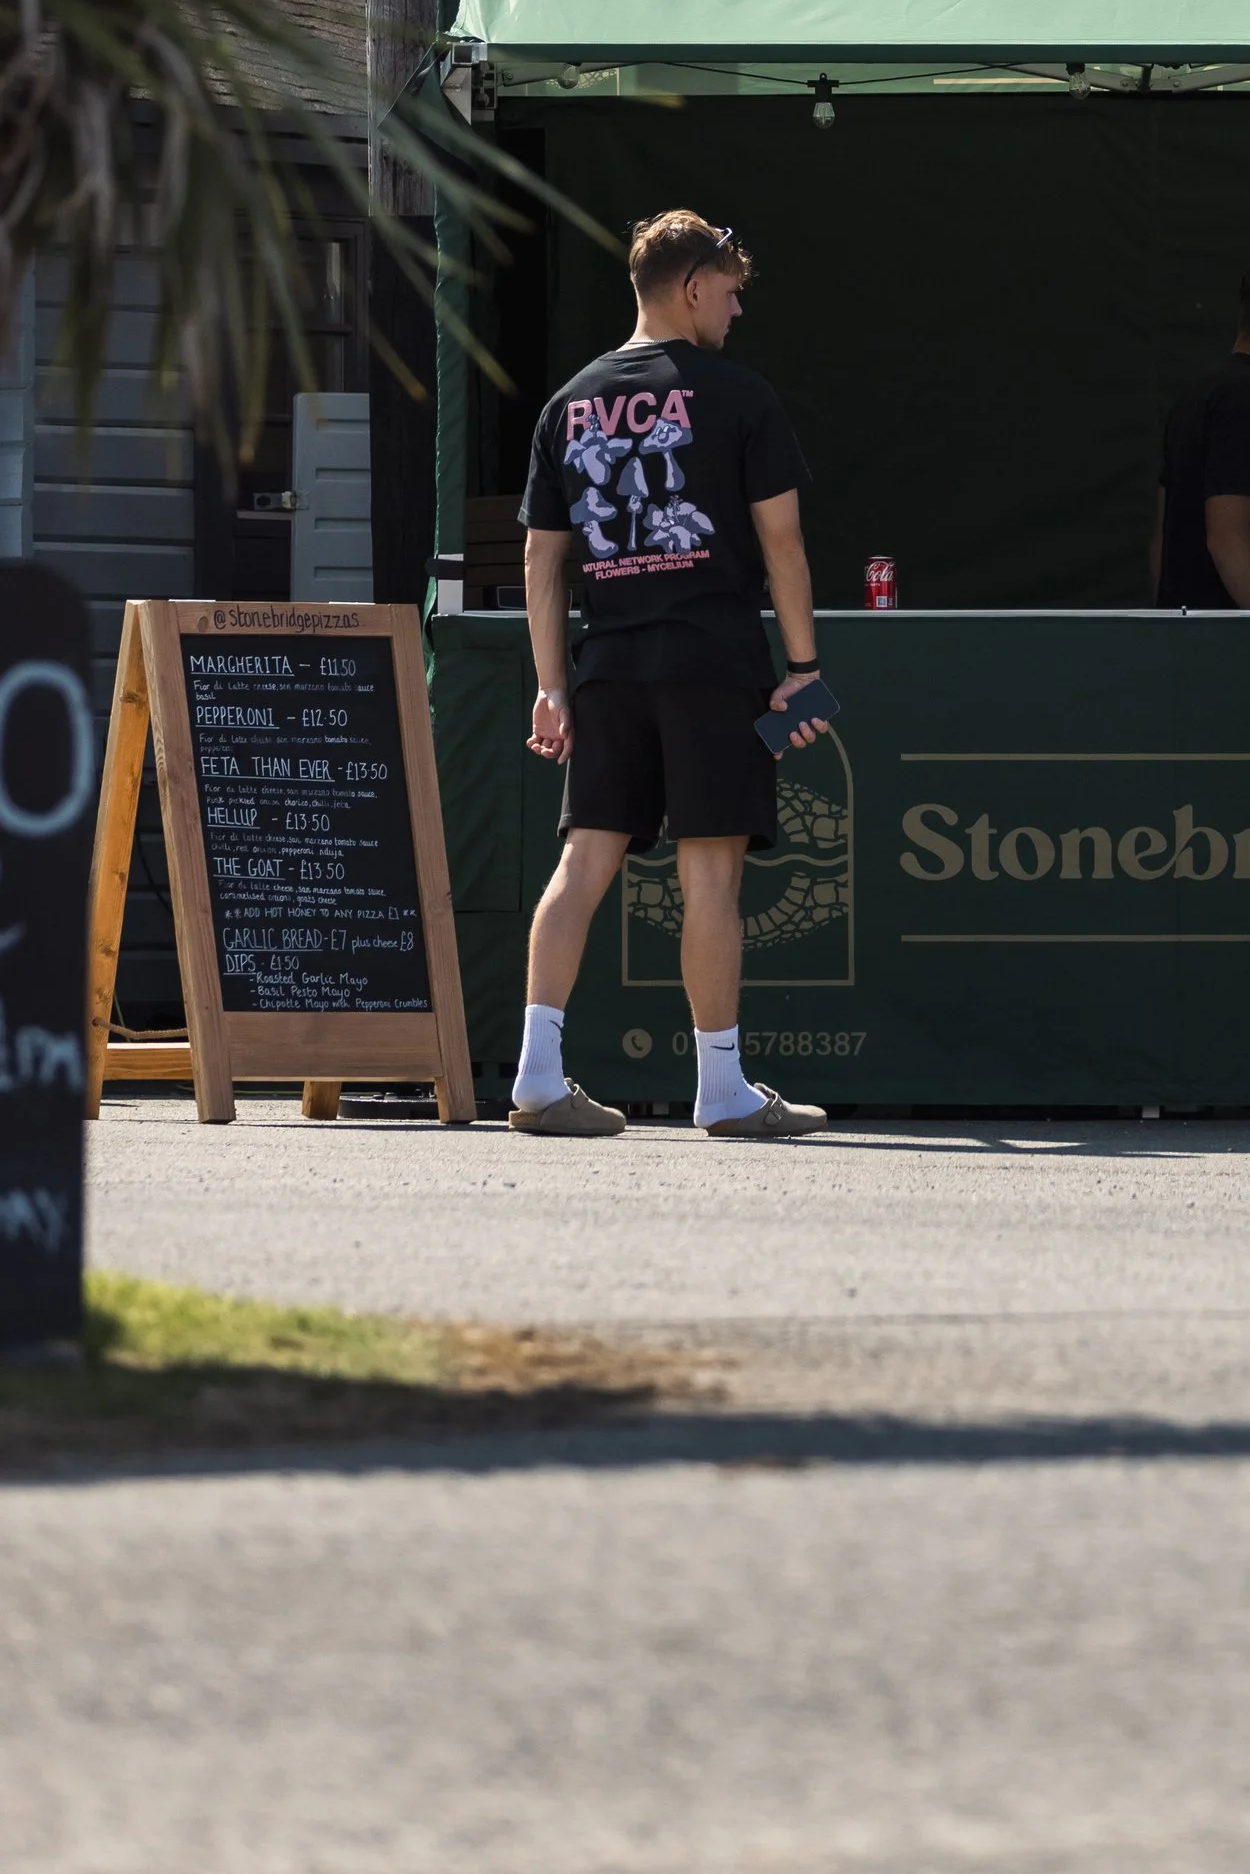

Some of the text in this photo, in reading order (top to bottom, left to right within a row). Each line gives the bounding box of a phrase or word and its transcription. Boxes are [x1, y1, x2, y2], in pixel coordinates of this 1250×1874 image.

[595, 566, 640, 580] FLOWERS
[647, 560, 694, 575] MYCELIUM
[618, 554, 663, 567] NETWORK
[190, 655, 294, 675] MARGHERITA
[193, 680, 210, 690] Fior
[213, 680, 223, 690] di
[195, 691, 216, 700] basil
[196, 705, 275, 727] PEPPERONI
[200, 756, 240, 775] FETA
[251, 756, 291, 777] THAN
[299, 758, 333, 780] EVER
[207, 807, 258, 826] HELLUP
[213, 857, 241, 876] THE
[248, 858, 283, 877] GOAT
[265, 906, 283, 917] HOT
[287, 906, 317, 918] HONEY
[320, 907, 330, 917] TO
[334, 909, 353, 918] ANY
[357, 909, 385, 919] PIZZA
[223, 927, 279, 950] GARLIC
[282, 928, 324, 950] BREAD
[351, 936, 372, 954] plus
[372, 936, 398, 948] cheese
[400, 931, 414, 951] £8
[225, 954, 257, 973] DIPS
[256, 972, 296, 985] Roasted
[302, 972, 336, 985] Garlic
[339, 972, 368, 992] Mayo
[258, 985, 285, 997] Basil
[291, 986, 318, 997] Pesto
[322, 987, 350, 1002] Mayo
[259, 998, 300, 1011] Chipotle
[305, 999, 330, 1012] Mayo
[332, 999, 350, 1008] with
[355, 999, 392, 1012] Pepperoni
[394, 998, 428, 1009] Crumbles
[672, 1031, 867, 1057] 05788387
